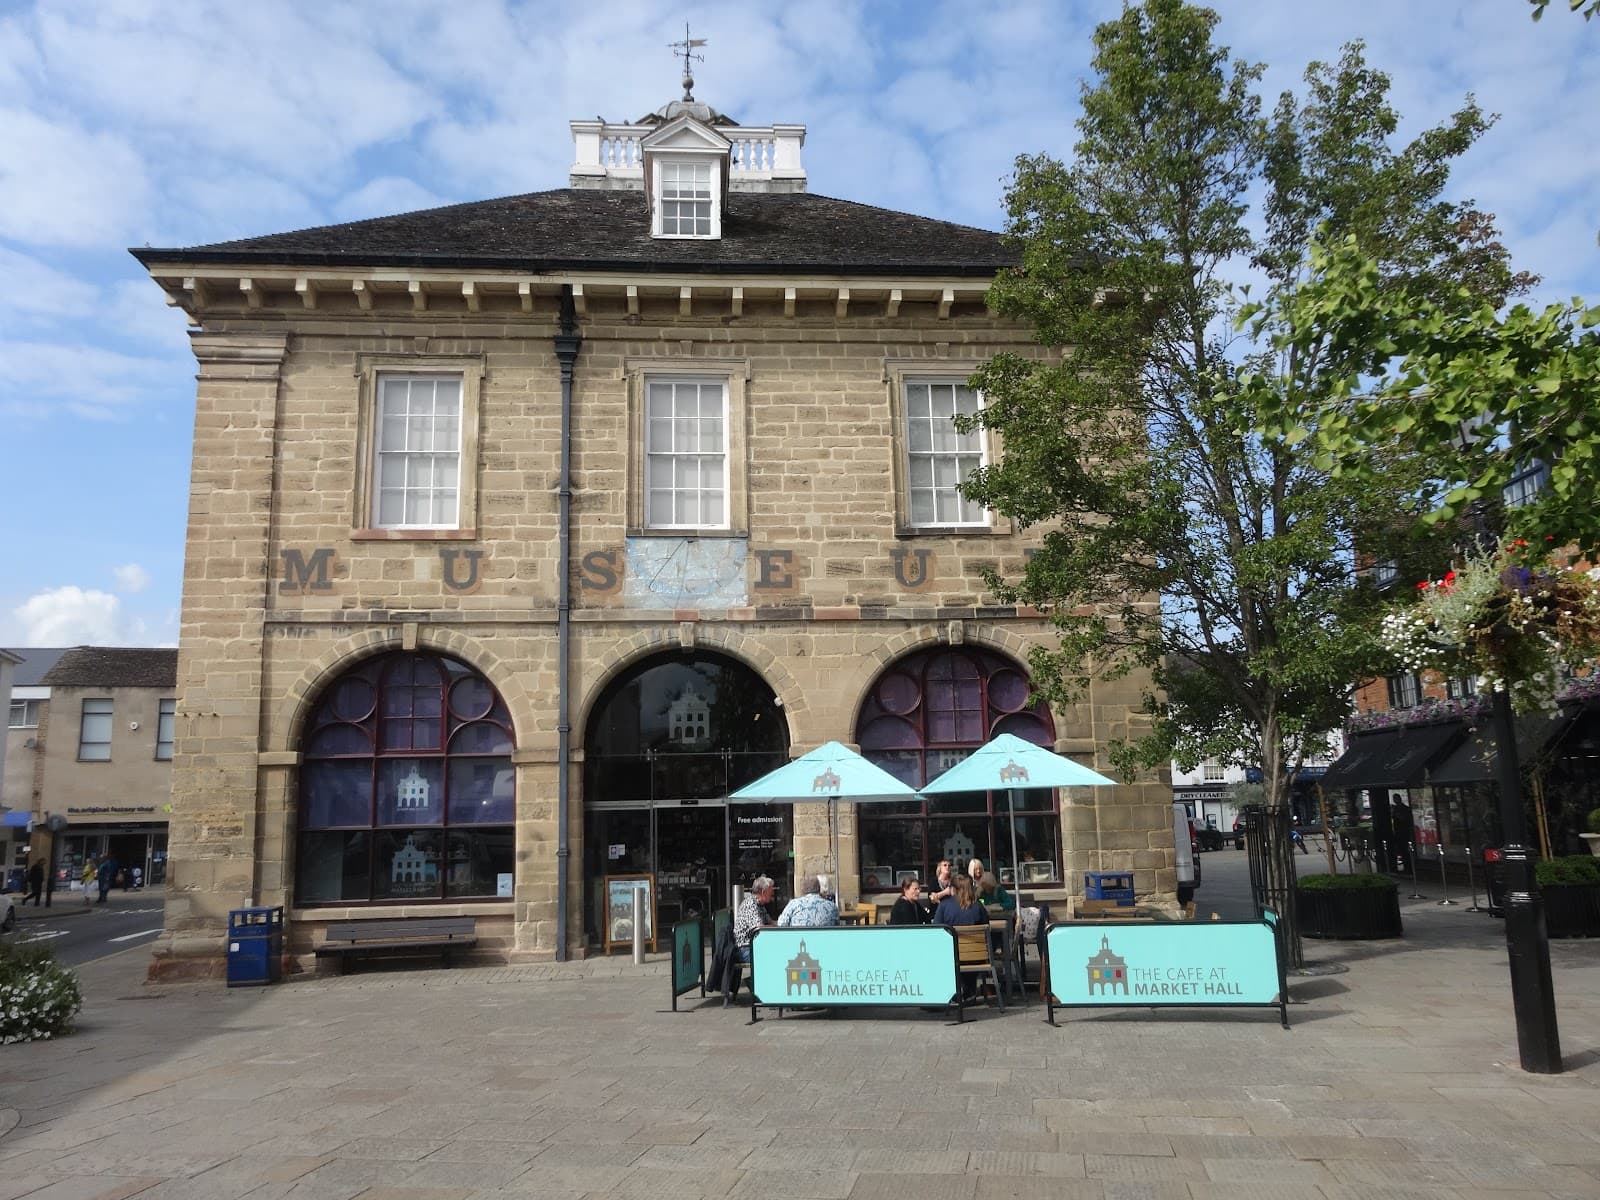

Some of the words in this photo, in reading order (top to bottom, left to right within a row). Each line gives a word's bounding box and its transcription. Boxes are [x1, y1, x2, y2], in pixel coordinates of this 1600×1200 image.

[827, 969, 851, 982] THE
[856, 969, 888, 982] CAFE
[894, 969, 910, 981] AT
[1133, 968, 1161, 980] THE
[1166, 967, 1202, 980] CAFE
[1209, 967, 1226, 979] AT
[827, 984, 885, 996] MARKET
[889, 984, 924, 996] HALL
[1134, 982, 1200, 995] MARKET
[1204, 981, 1243, 995] HALL
